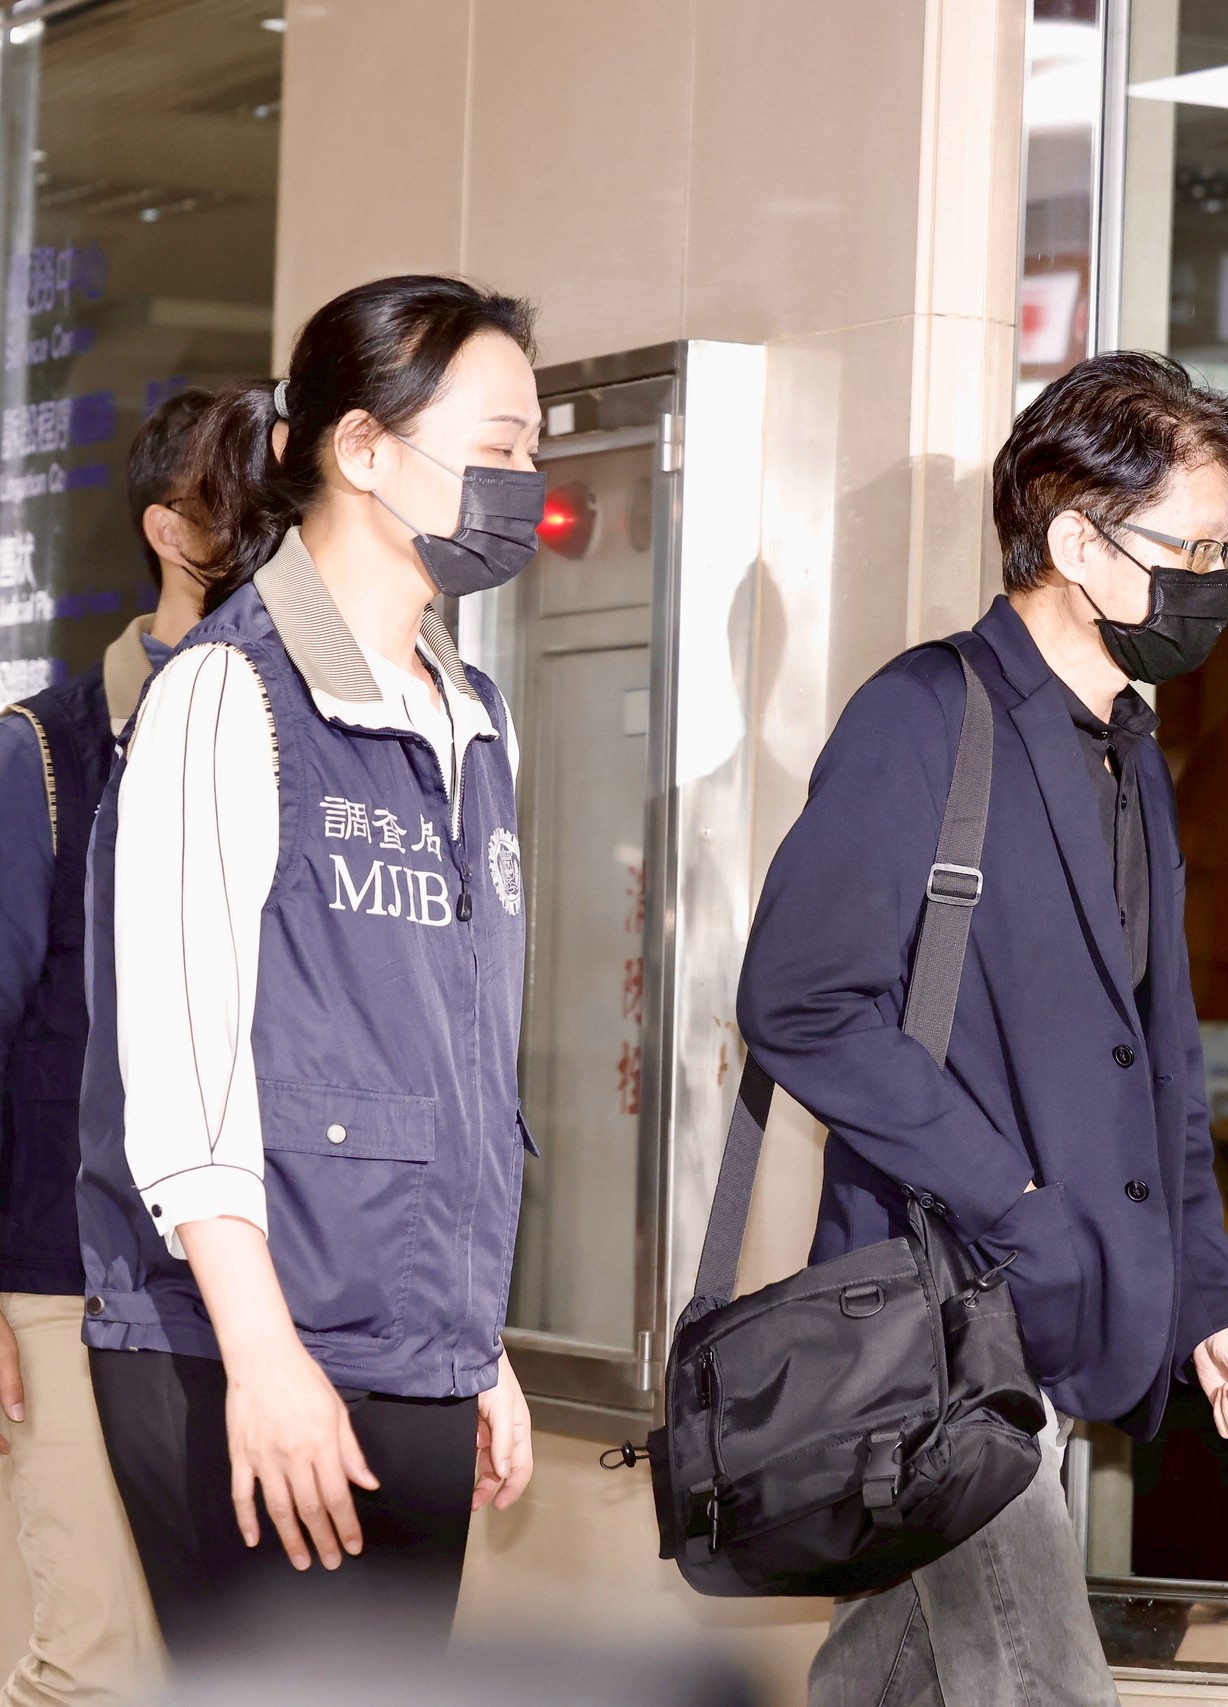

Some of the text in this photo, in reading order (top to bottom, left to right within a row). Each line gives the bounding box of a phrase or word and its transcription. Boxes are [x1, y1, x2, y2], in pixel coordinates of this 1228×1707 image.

[319, 795, 443, 862] 調查局
[329, 854, 452, 927] MJIB
